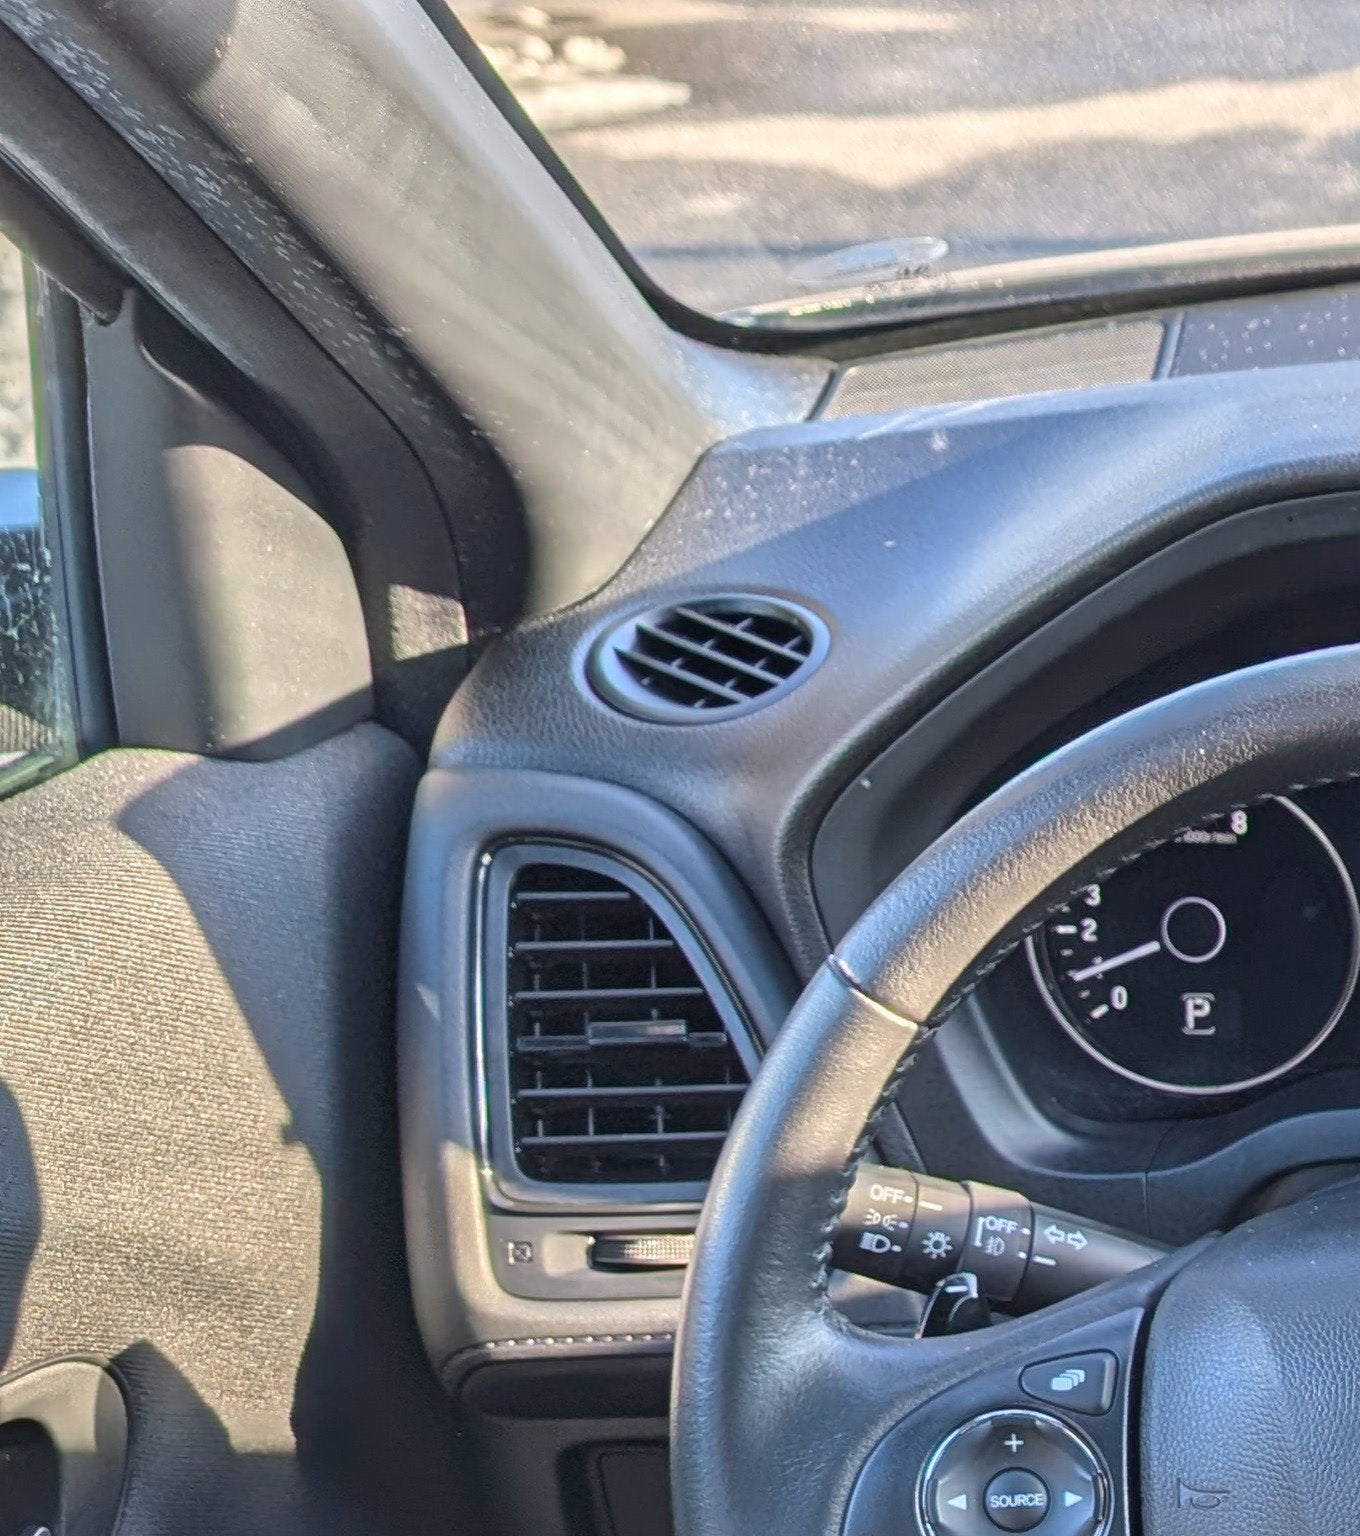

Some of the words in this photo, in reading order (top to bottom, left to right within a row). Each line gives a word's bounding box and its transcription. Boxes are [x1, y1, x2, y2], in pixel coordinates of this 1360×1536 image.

[1231, 809, 1248, 836] 8
[1084, 883, 1101, 907] 3
[1080, 917, 1099, 942] 2
[1111, 985, 1128, 1010] 0
[870, 1184, 905, 1203] OFF
[985, 1214, 1019, 1235] OFF
[989, 1493, 1044, 1509] SOURCE
